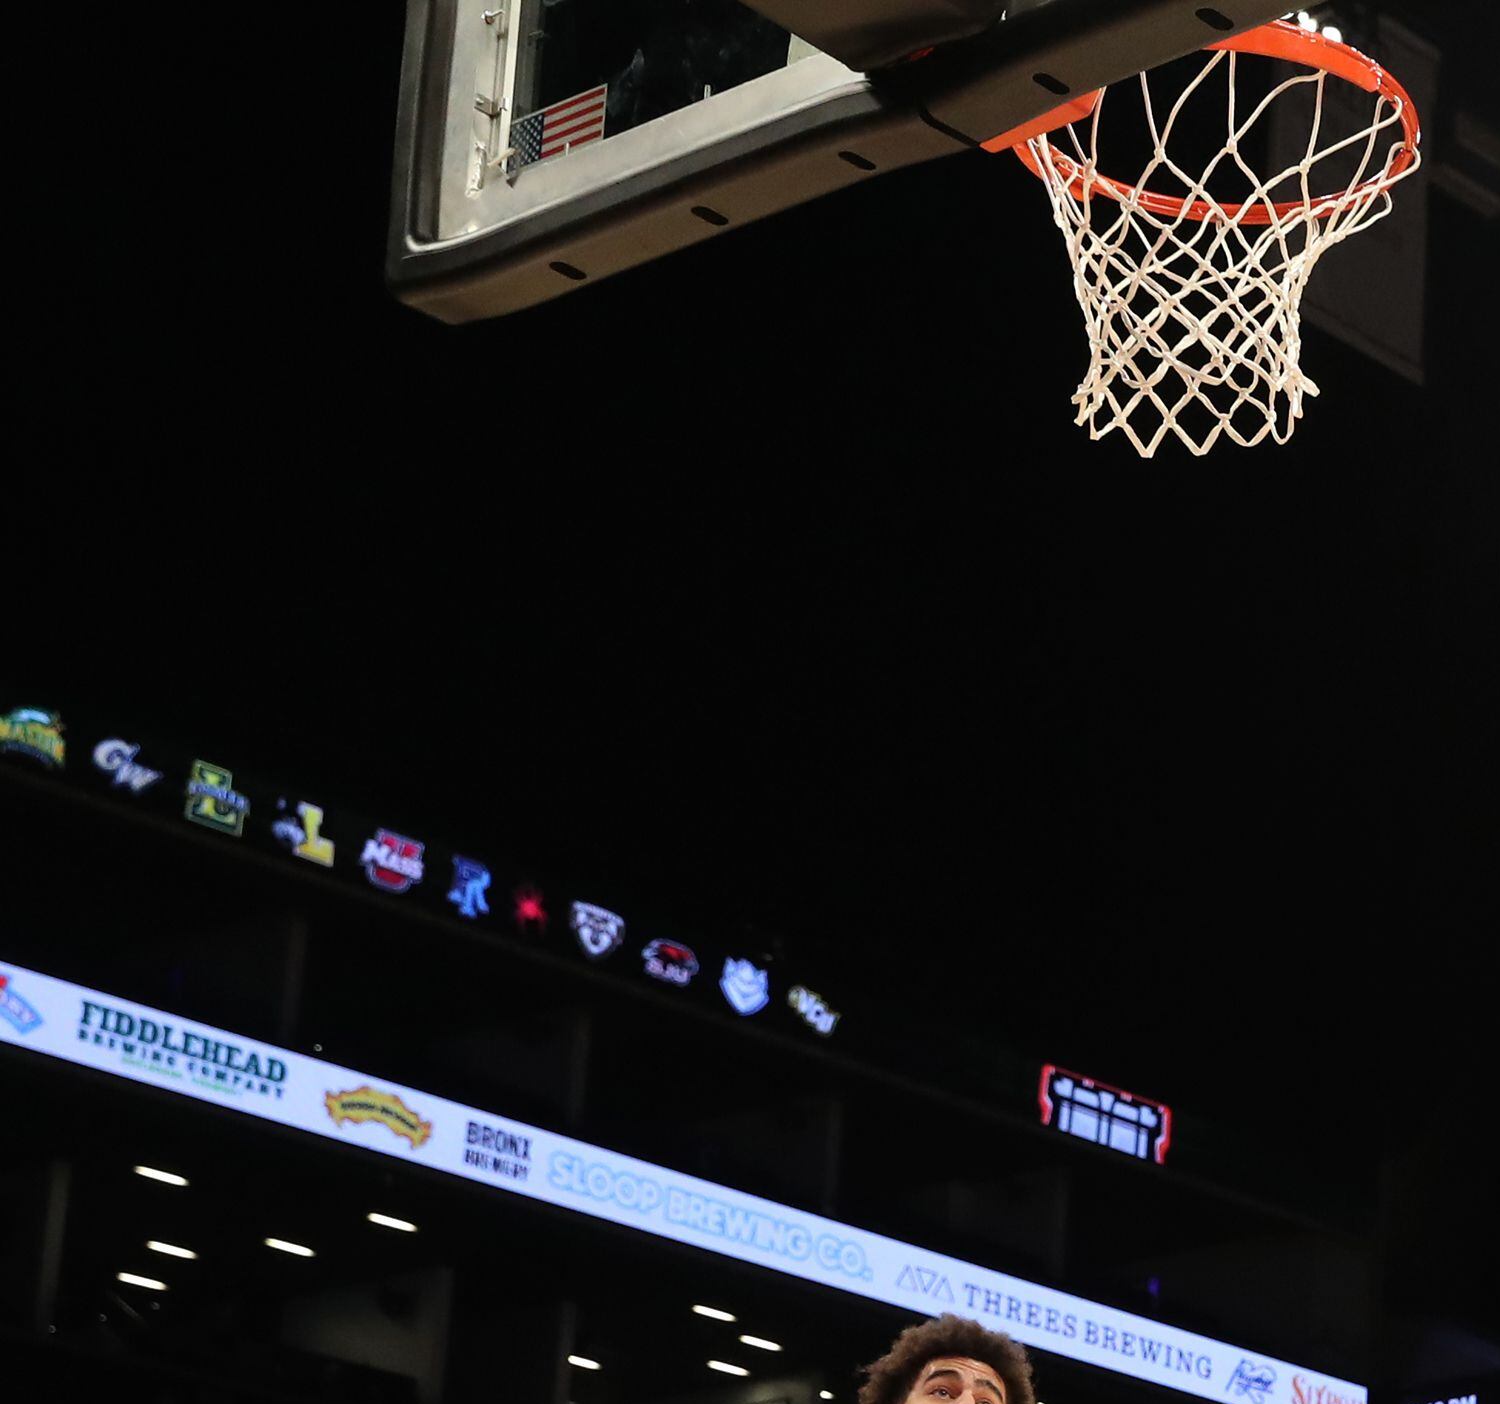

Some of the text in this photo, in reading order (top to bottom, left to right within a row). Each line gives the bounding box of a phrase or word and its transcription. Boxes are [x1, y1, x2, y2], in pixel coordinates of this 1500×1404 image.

[76, 1028, 177, 1067] BREWING
[188, 1060, 287, 1099] COMPANY
[80, 1000, 288, 1084] FIDDLEHEAD
[465, 1120, 534, 1161] BRONX
[547, 1150, 875, 1283] SLOOP BREWING CO.
[963, 1281, 1213, 1381] THREES BREWING
